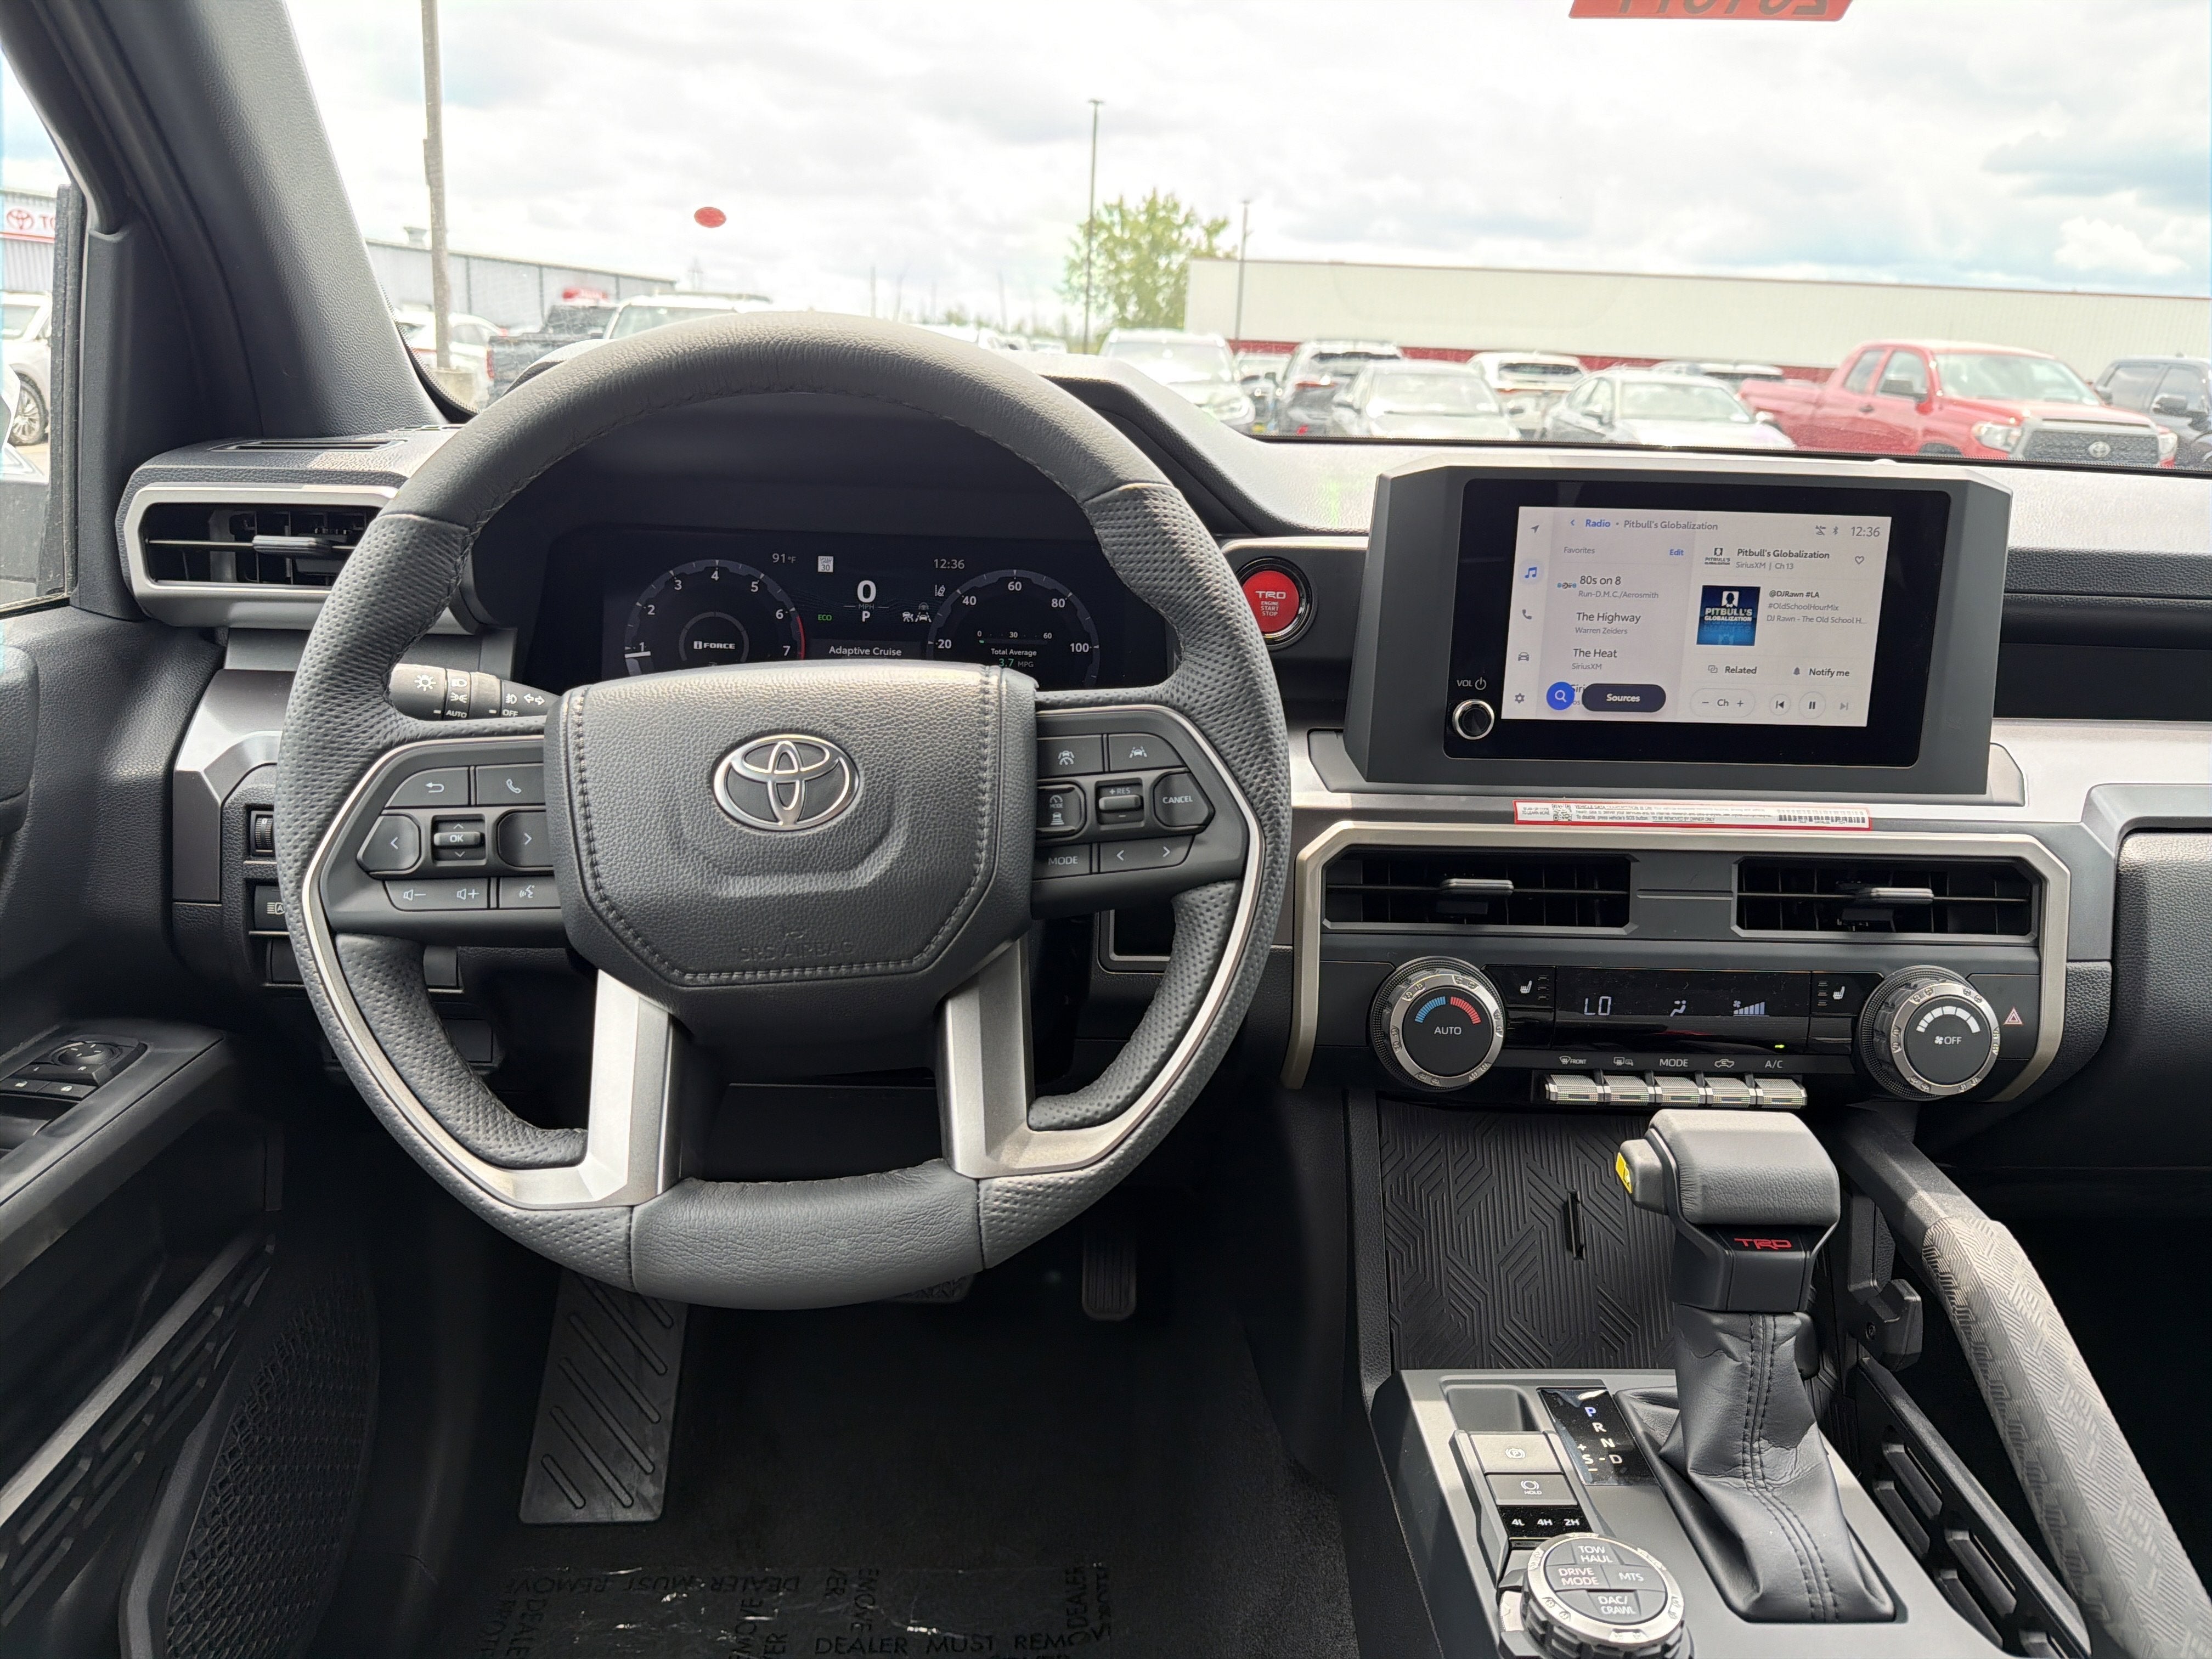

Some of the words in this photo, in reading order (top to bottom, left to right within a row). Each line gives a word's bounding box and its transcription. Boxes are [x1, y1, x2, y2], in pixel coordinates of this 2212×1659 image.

[1624, 520, 1658, 529] Pitbull's
[1660, 521, 1718, 531] Globalization
[1850, 526, 1880, 537] 12:36
[1737, 549, 1771, 557] Pitbull's
[1773, 549, 1830, 559] Globalization
[933, 558, 965, 569] 12:36
[711, 571, 719, 581] 4
[1580, 575, 1597, 585] 80s
[1615, 577, 1621, 585] 8
[674, 580, 682, 590] 3
[751, 582, 759, 592] 5
[1008, 582, 1022, 591] 60
[857, 580, 877, 603] 0
[1255, 591, 1286, 599] TRD
[1769, 590, 1804, 599] @DJRawn
[962, 596, 977, 606] 40
[1051, 599, 1065, 608] 80
[647, 605, 655, 615] 2
[1705, 608, 1752, 616] PITBULL'S
[1768, 603, 1839, 611] #OldSchoolHourMix
[775, 609, 783, 619] 6
[862, 611, 871, 622] P
[1577, 612, 1594, 621] The
[1597, 613, 1641, 624] Highway
[639, 642, 645, 652] 1
[938, 639, 952, 649] 20
[1070, 642, 1089, 653] 100
[783, 646, 791, 656] 7
[829, 646, 870, 657] Adaptive
[873, 647, 902, 656] Cruise
[1573, 648, 1591, 657] The
[1593, 649, 1617, 658] Heat
[1725, 666, 1757, 674] Related
[1809, 668, 1835, 678] Notify
[1606, 693, 1640, 702] Sources
[446, 709, 467, 718] AUTO
[1163, 795, 1193, 804] CANCEL
[1048, 856, 1078, 865] MODE
[1584, 996, 1611, 1016] LO
[1434, 1026, 1462, 1036] AUTO
[1944, 1036, 1962, 1045] OFF
[1660, 1058, 1689, 1067] MODE
[1765, 1058, 1783, 1069] A/C
[1734, 1238, 1792, 1250] TRD
[1584, 1407, 1597, 1417] P
[1592, 1422, 1607, 1432] R
[1600, 1438, 1616, 1448] N
[1582, 1454, 1594, 1464] S
[1609, 1454, 1623, 1464] D
[1578, 1545, 1605, 1554] TOW
[1559, 1567, 1594, 1576] DRIVE
[1561, 1577, 1599, 1586] MODE
[1619, 1573, 1644, 1582] MTS
[1598, 1596, 1628, 1605] DAC/
[1601, 1606, 1636, 1615] CRAWL
[815, 1636, 908, 1656] DEALER
[926, 1634, 994, 1654] MUST
